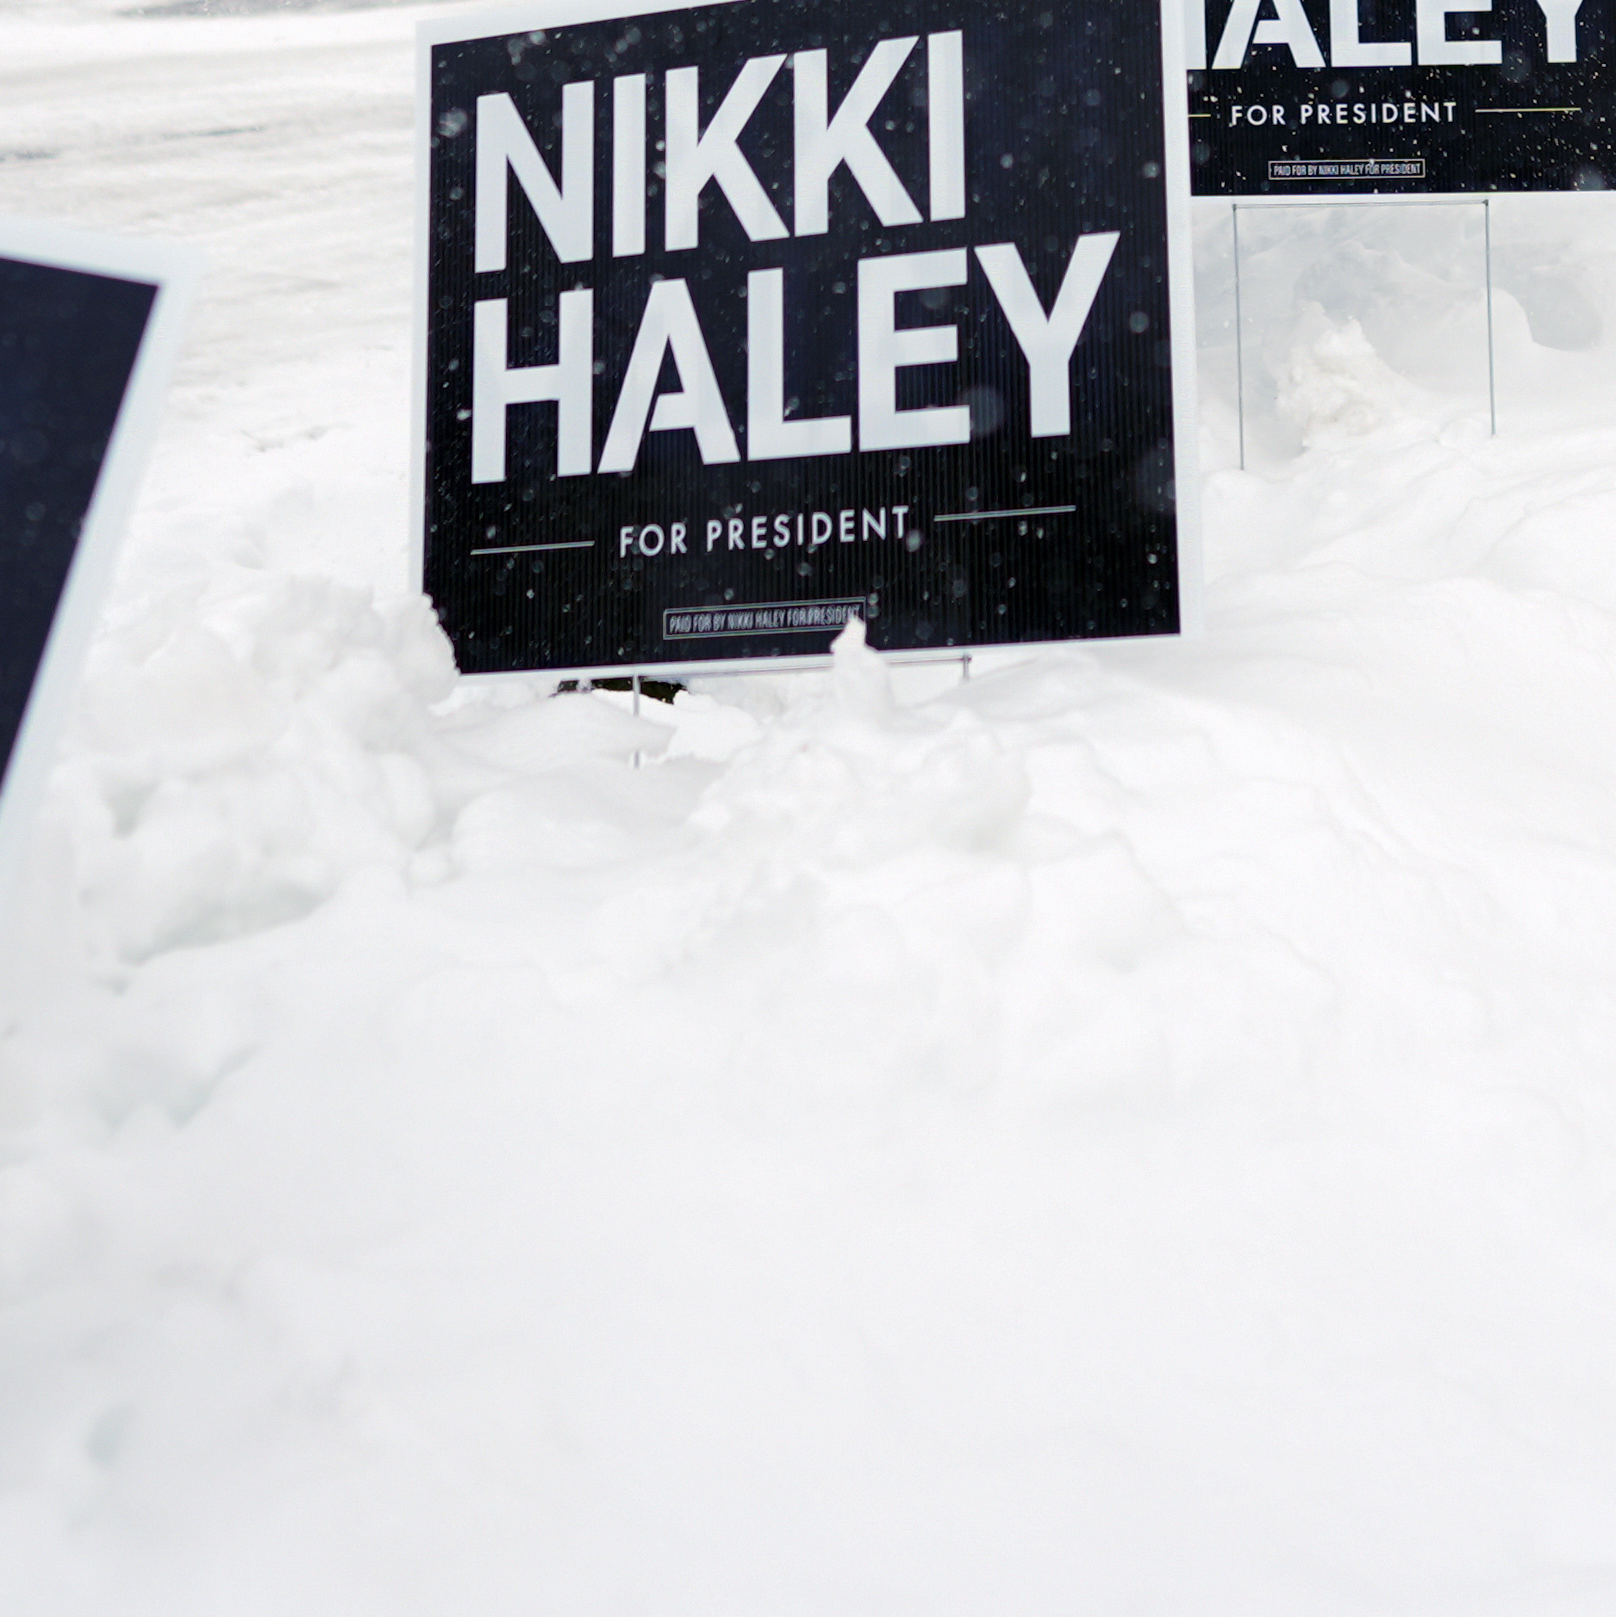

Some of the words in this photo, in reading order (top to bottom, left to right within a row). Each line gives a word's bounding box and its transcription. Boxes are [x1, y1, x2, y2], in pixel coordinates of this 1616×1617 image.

[1230, 105, 1285, 127] FOR
[1301, 102, 1457, 125] PRESIDENT
[475, 30, 965, 273] NIKKI
[1273, 165, 1290, 176] PAID
[1292, 165, 1306, 176] FOR
[1307, 164, 1318, 175] BY
[472, 231, 1121, 484] HALEY
[620, 522, 687, 558] FOR
[707, 505, 909, 552] PRESIDENT
[669, 613, 691, 634] PAID
[692, 612, 711, 632] FOR
[712, 611, 726, 631] BY
[727, 610, 753, 630] NIKKI
[755, 609, 785, 629] HALEY
[786, 606, 806, 627] FOR
